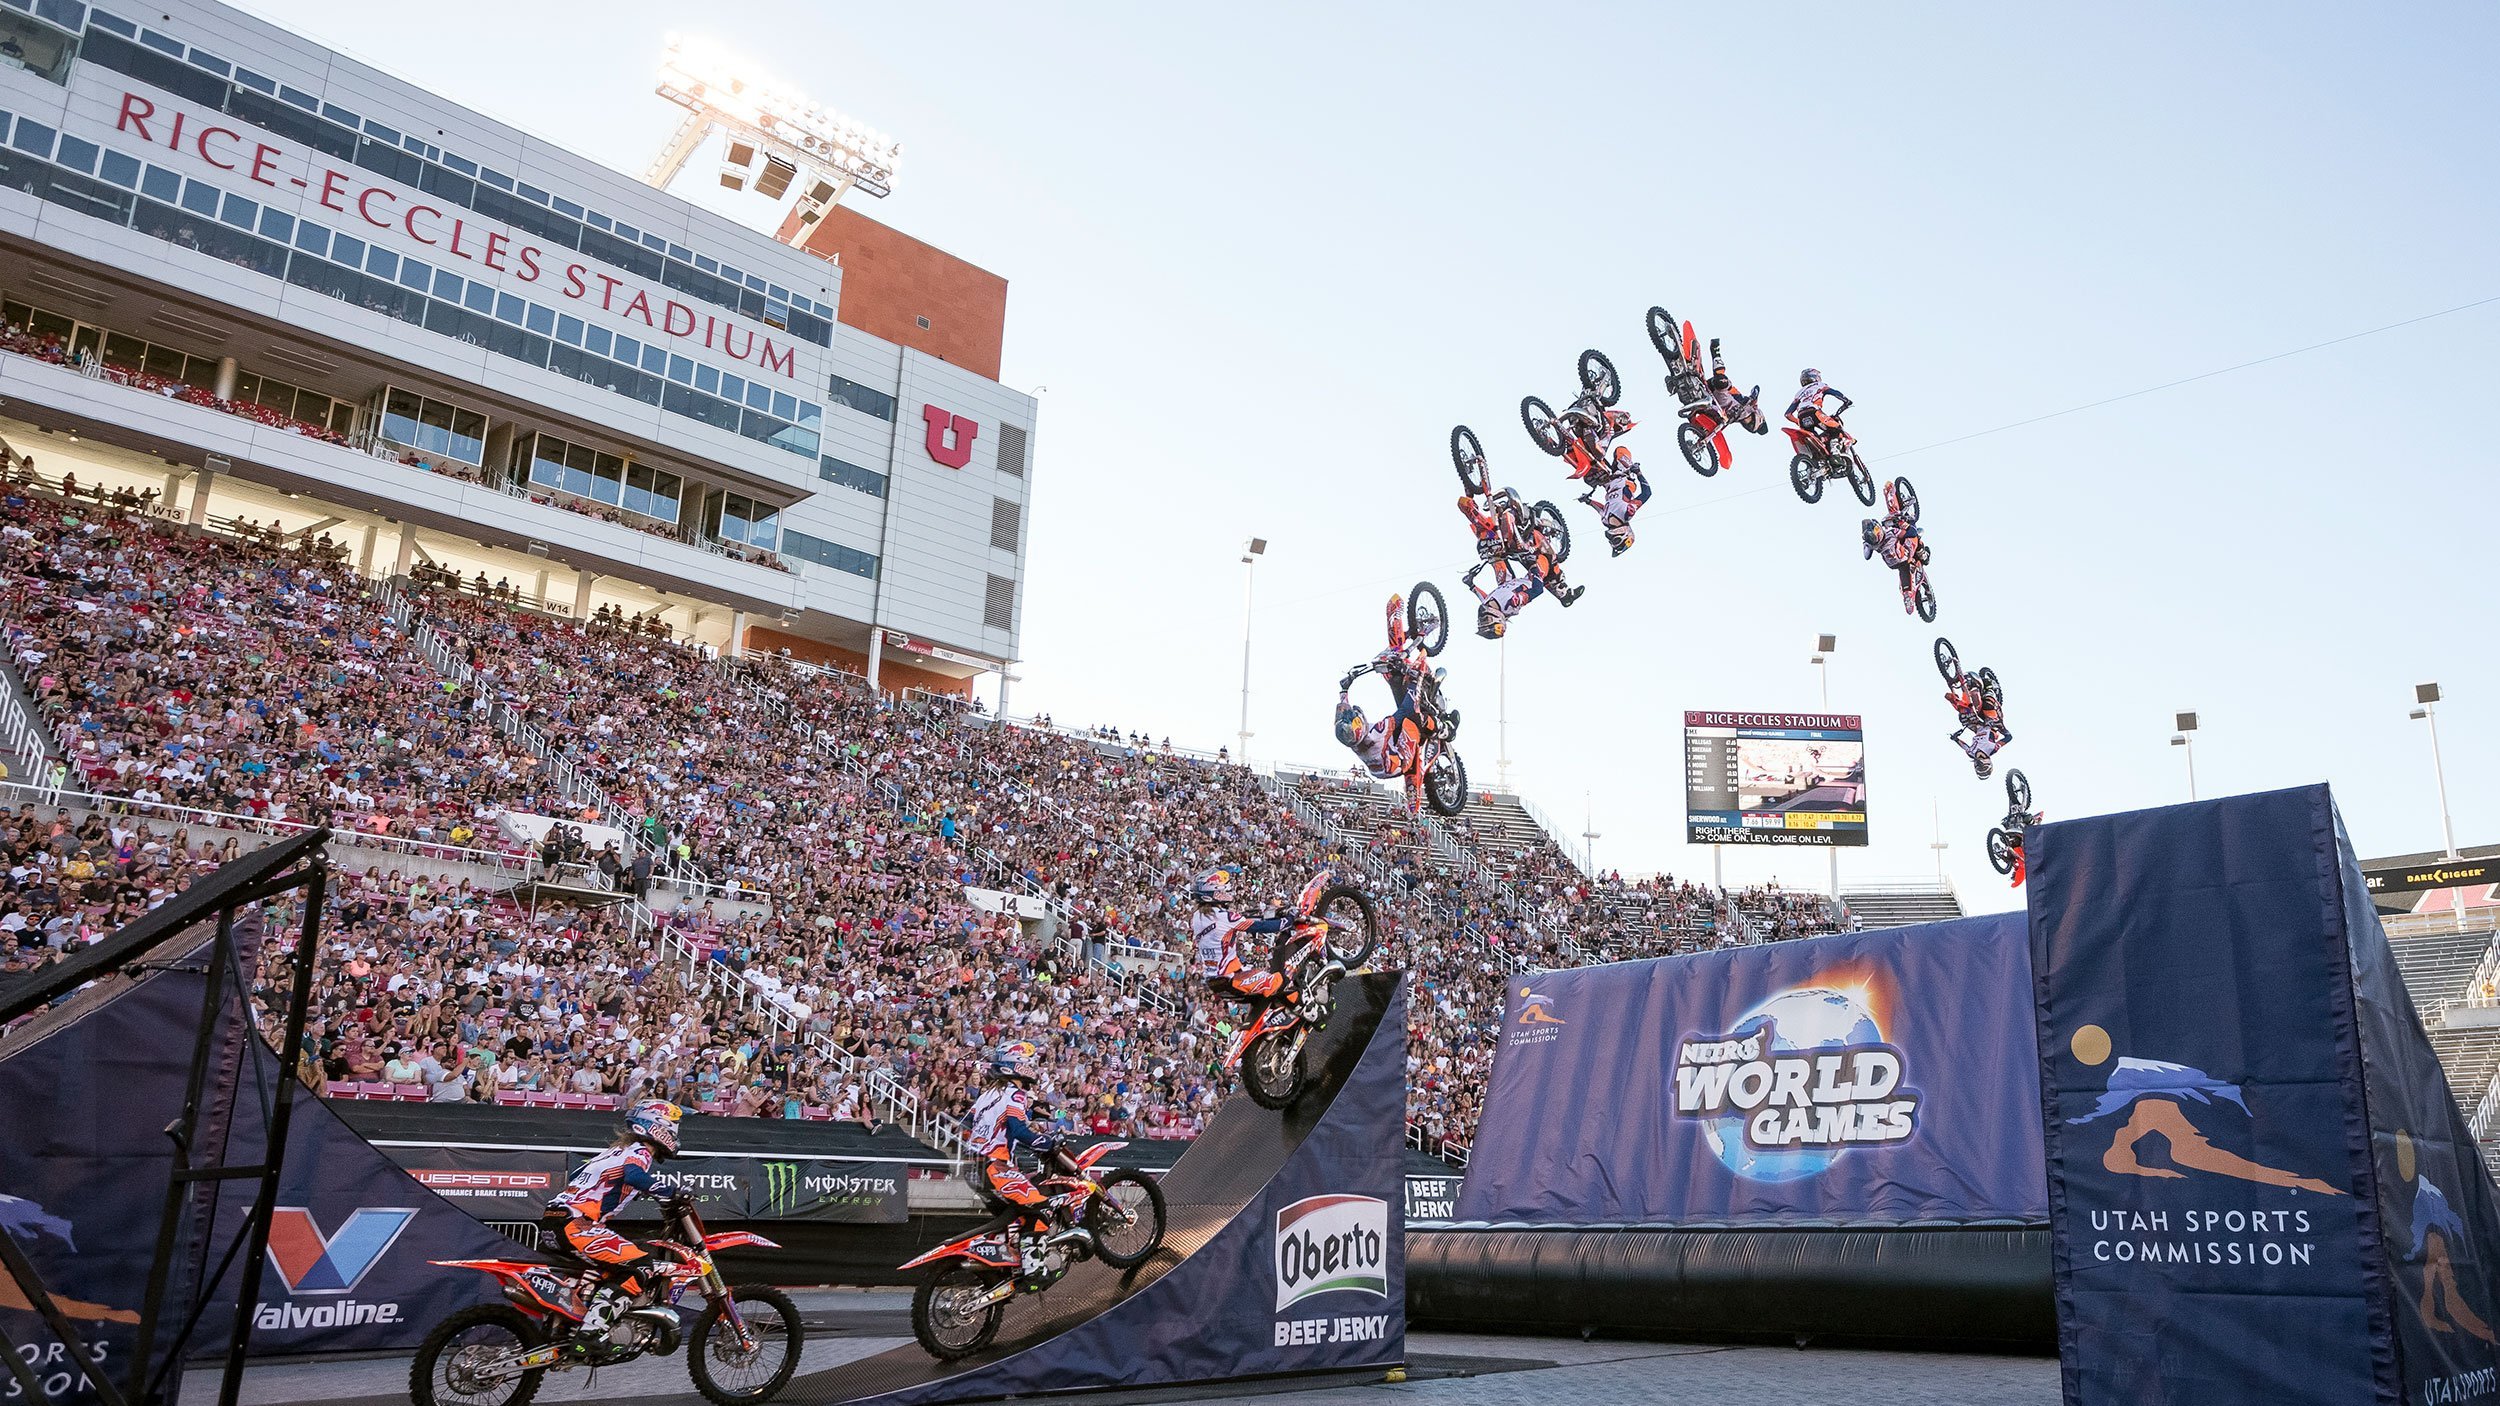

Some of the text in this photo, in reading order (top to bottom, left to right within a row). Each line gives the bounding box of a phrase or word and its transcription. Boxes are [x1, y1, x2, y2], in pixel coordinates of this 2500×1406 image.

[117, 92, 795, 378] RICE-ECCLES STADIUM
[923, 403, 979, 469] U
[152, 505, 181, 520] W13
[546, 602, 569, 614] W14
[796, 664, 814, 675] W15
[1705, 713, 1841, 728] RICE-ECCLES STADIUM
[1322, 769, 1338, 777] W17
[1688, 815, 1720, 823] SHERWOOD
[1696, 827, 1721, 835] RIGHT
[1772, 834, 1797, 843] COME
[2442, 868, 2481, 880] BIGGER
[1000, 896, 1018, 912] 14
[1510, 1027, 1559, 1039] UTAH SPORTS
[1510, 1035, 1558, 1046] COMMISSION
[1679, 1028, 1766, 1064] NITRO
[1676, 1052, 1901, 1111] WORLD
[1750, 1100, 1916, 1145] GAMES
[804, 1174, 897, 1195] MONSTER
[1412, 1180, 1446, 1198] BEEF
[474, 1189, 497, 1198] BRAKE
[498, 1190, 528, 1198] SYSTEMS
[819, 1196, 882, 1206] ENERGY
[1412, 1200, 1454, 1218] JERKY
[2091, 1210, 2311, 1233] UTAH SPORTS
[1282, 1222, 1380, 1288] Oberto
[2094, 1240, 2311, 1266] COMMISSION
[1274, 1315, 1390, 1346] BEEF JERKY
